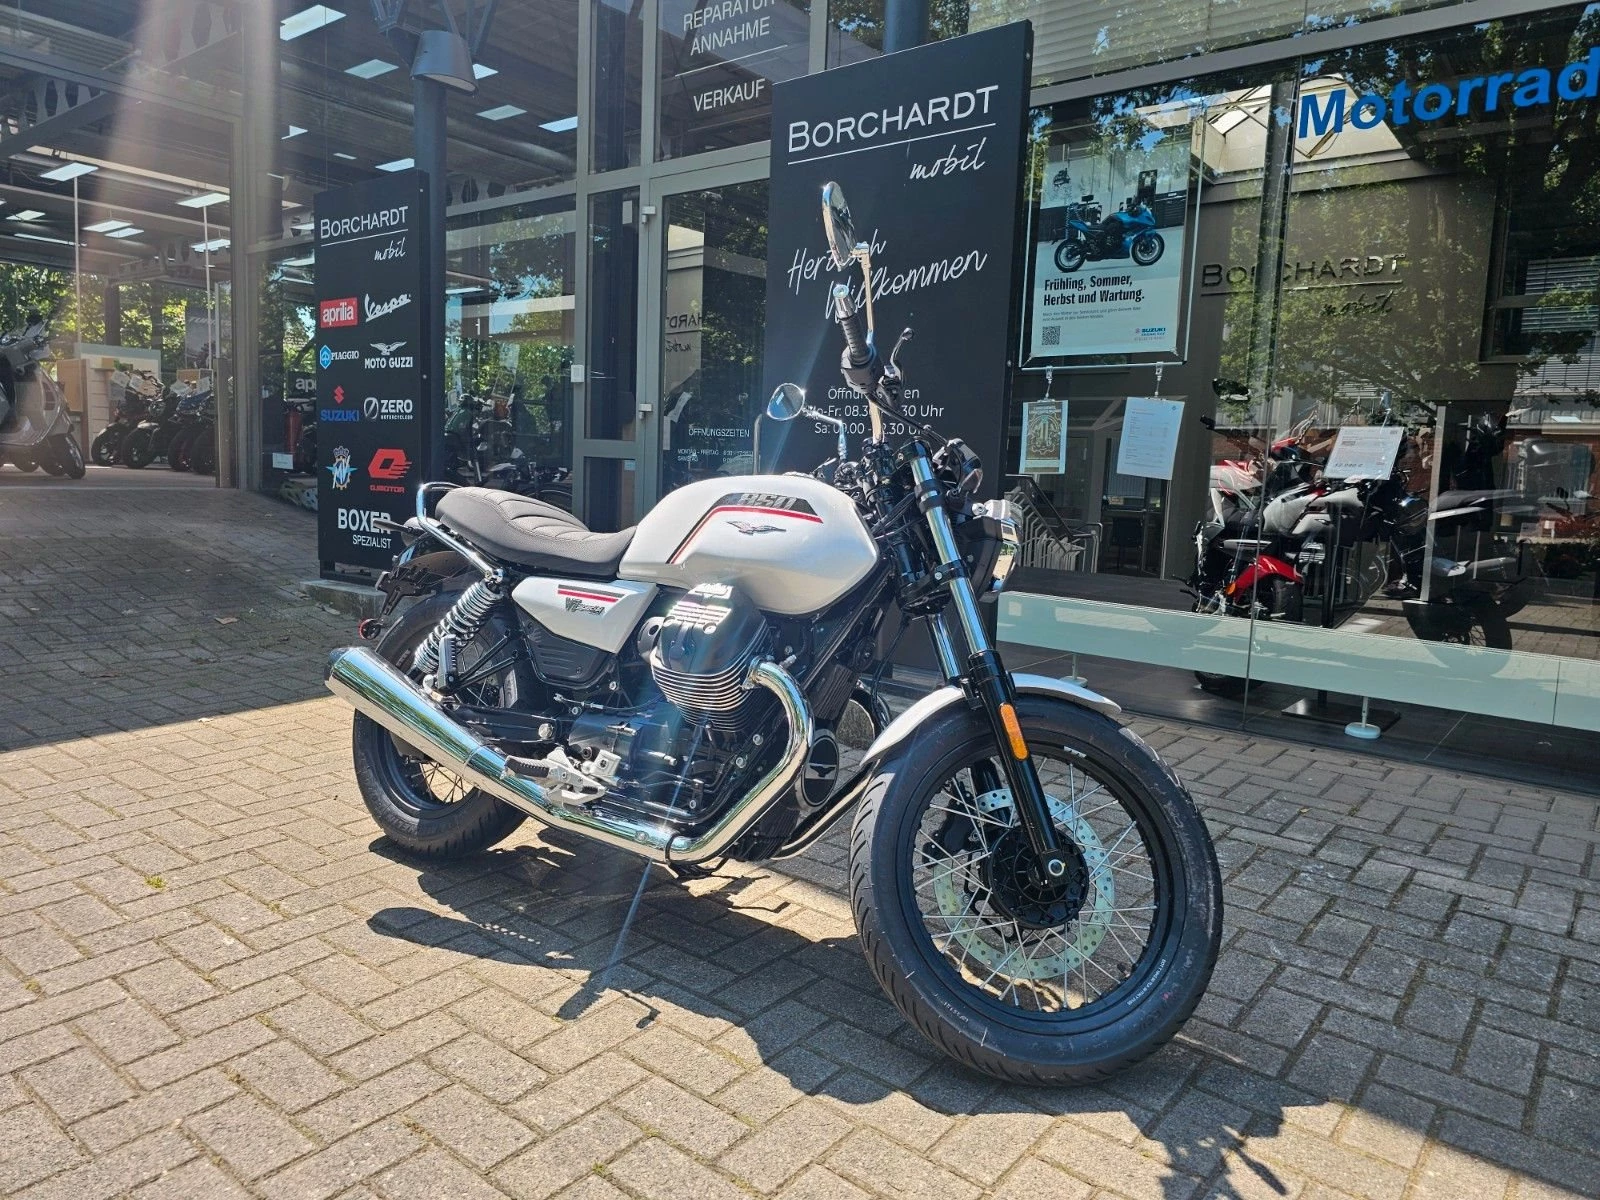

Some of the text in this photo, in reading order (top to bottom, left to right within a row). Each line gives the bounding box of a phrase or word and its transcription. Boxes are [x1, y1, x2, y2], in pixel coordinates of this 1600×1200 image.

[690, 16, 771, 56] ANNAHME
[693, 78, 766, 112] VERKAUF
[1298, 46, 1600, 139] Motorrad
[788, 85, 999, 153] BORCHARDT
[909, 137, 987, 180] mobil
[320, 206, 409, 239] BORCHARDT
[374, 237, 407, 261] mobil
[1044, 274, 1133, 292] Frühling, Sommer,
[1043, 289, 1145, 306] Herbst und Wartung.
[322, 293, 412, 326] aprilia Vespa
[331, 350, 413, 369] PIAGGIO MOTO GUZZI
[320, 409, 360, 422] SUZUKI
[380, 399, 413, 413] ZERO
[844, 405, 870, 417] 08.3
[920, 404, 945, 417] Uhr
[815, 422, 830, 434] Sa:
[737, 493, 798, 510] 850
[337, 508, 392, 534] BOXER
[352, 534, 392, 549] SPEZIALIST
